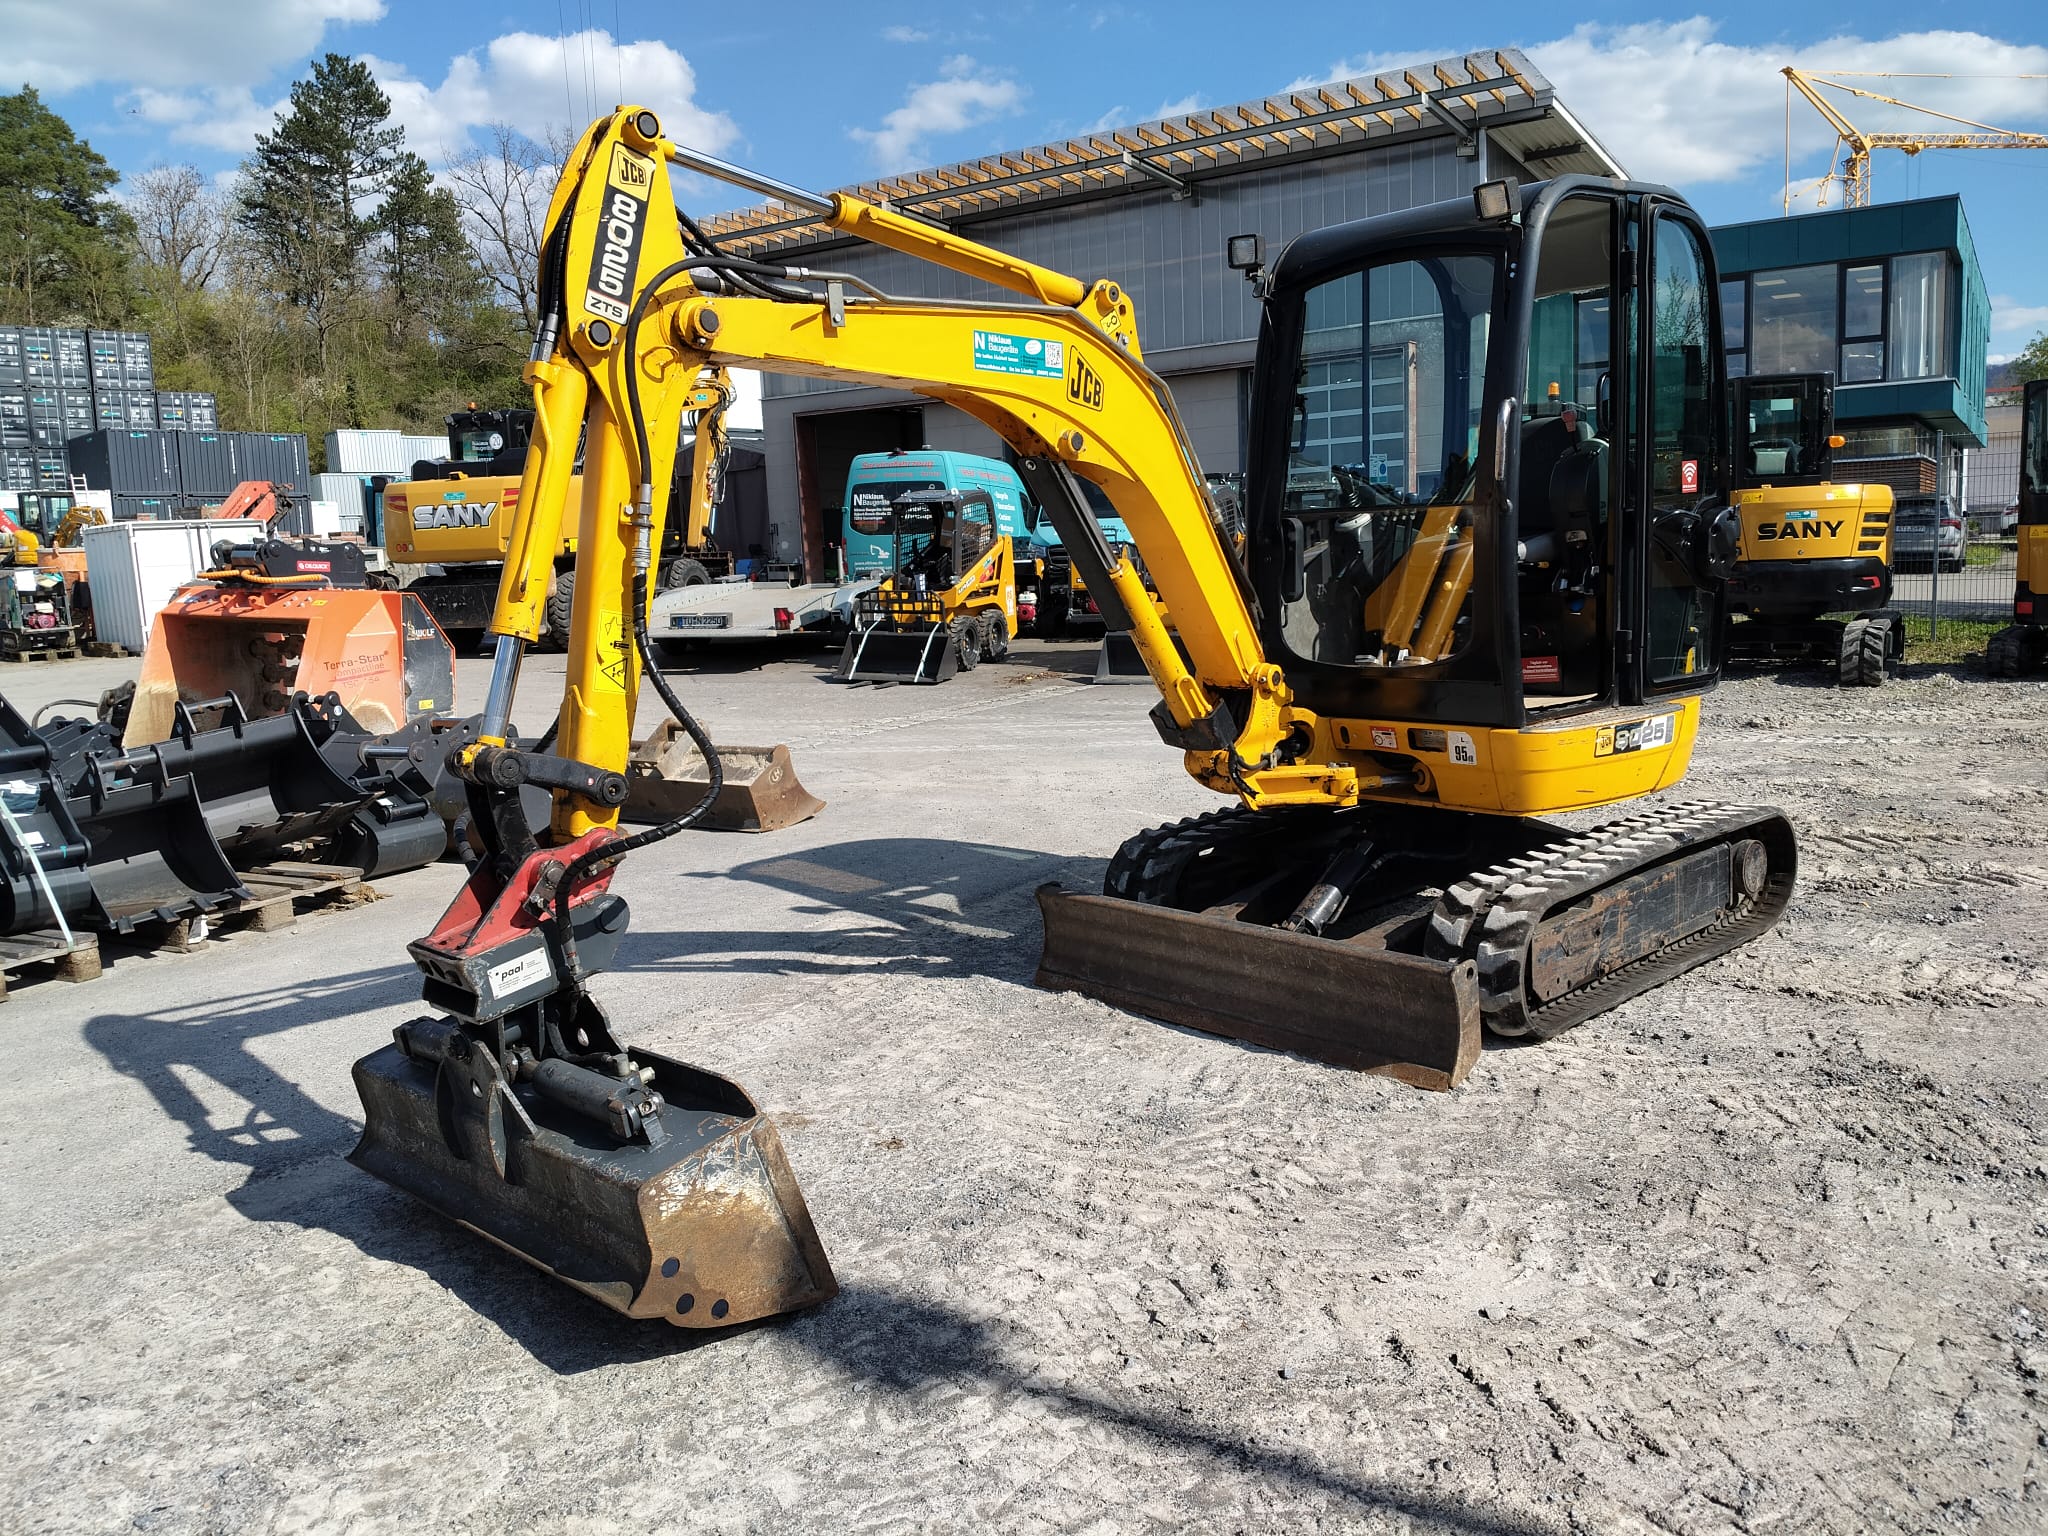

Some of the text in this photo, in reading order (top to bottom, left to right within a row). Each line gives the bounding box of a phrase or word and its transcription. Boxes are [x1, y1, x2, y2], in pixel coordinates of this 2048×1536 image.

[621, 156, 645, 185] JCB
[598, 193, 638, 297] 8025
[590, 296, 623, 318] ZTS
[1070, 357, 1101, 407] JCB
[413, 502, 498, 531] SANY
[1757, 520, 1845, 541] SANY
[1615, 722, 1665, 751] 8025
[1454, 745, 1468, 762] 95
[501, 961, 524, 982] paal
